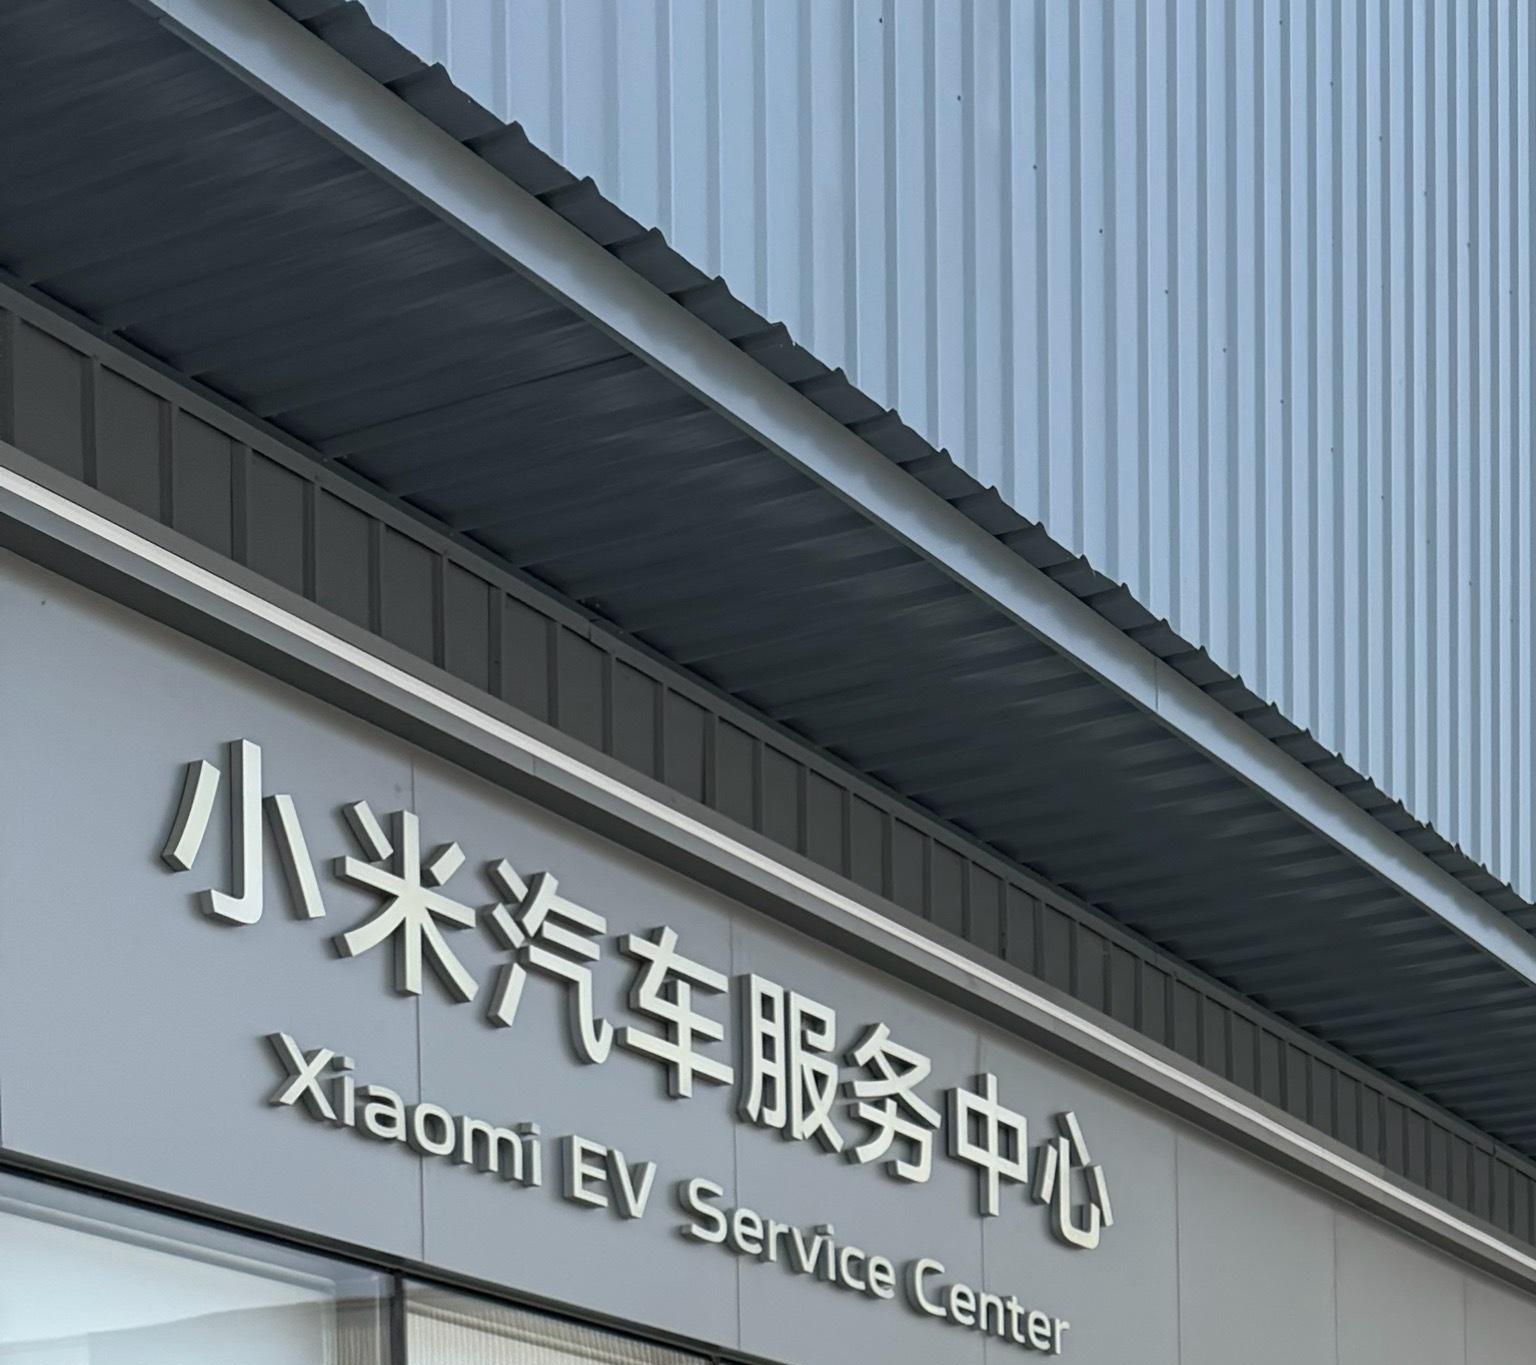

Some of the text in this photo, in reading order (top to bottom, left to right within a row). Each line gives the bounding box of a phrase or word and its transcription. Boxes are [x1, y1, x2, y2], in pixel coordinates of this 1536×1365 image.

[160, 739, 1115, 1250] 小米汽车服务中心
[266, 1032, 1071, 1356] Xiaomi EV Service Center
